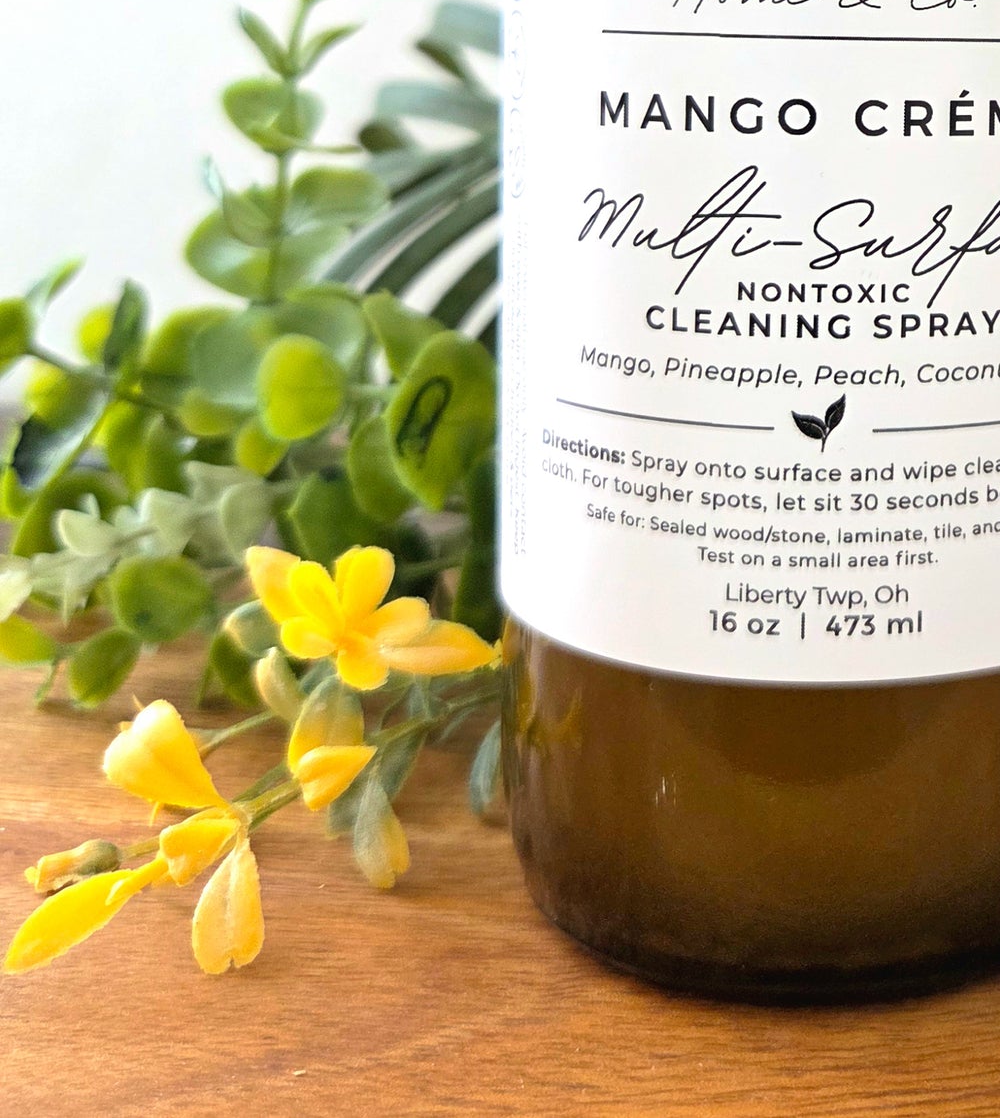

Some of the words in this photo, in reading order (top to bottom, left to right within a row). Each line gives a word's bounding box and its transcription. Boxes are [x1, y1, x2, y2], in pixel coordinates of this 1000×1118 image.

[600, 90, 817, 136] MANGO
[737, 281, 910, 304] NONTOXIC
[645, 305, 851, 340] CLEANING
[873, 309, 1000, 340] SPRAY
[581, 345, 655, 378] Mango,
[664, 357, 803, 389] Pineapple,
[814, 363, 906, 388] Peach,
[543, 429, 626, 465] Directions:
[631, 450, 688, 478] Spray
[694, 461, 747, 479] onto
[754, 463, 842, 482] surface
[850, 462, 894, 482] and
[903, 461, 957, 483] wipe
[542, 458, 577, 482] cloth.
[583, 468, 608, 489] For
[614, 476, 694, 504] tougher
[700, 491, 767, 513] spots,
[776, 492, 806, 511] let
[814, 493, 843, 512] sit
[850, 493, 878, 512] 30
[886, 486, 979, 511] seconds
[587, 503, 616, 523] Safe
[620, 510, 645, 529] for:
[650, 516, 707, 537] Sealed
[713, 525, 830, 546] wood/stone,
[837, 527, 927, 544] laminate,
[933, 522, 966, 540] tile,
[697, 546, 735, 564] Test
[741, 554, 765, 566] on
[771, 555, 782, 567] a
[788, 552, 841, 569] small
[847, 555, 889, 568] area
[895, 550, 938, 567] first.
[726, 582, 807, 610] Liberty
[812, 586, 868, 610] Twp,
[874, 583, 909, 604] Oh
[709, 609, 737, 633] 16
[747, 618, 780, 636] oz
[825, 614, 876, 637] 473
[887, 610, 922, 635] ml
